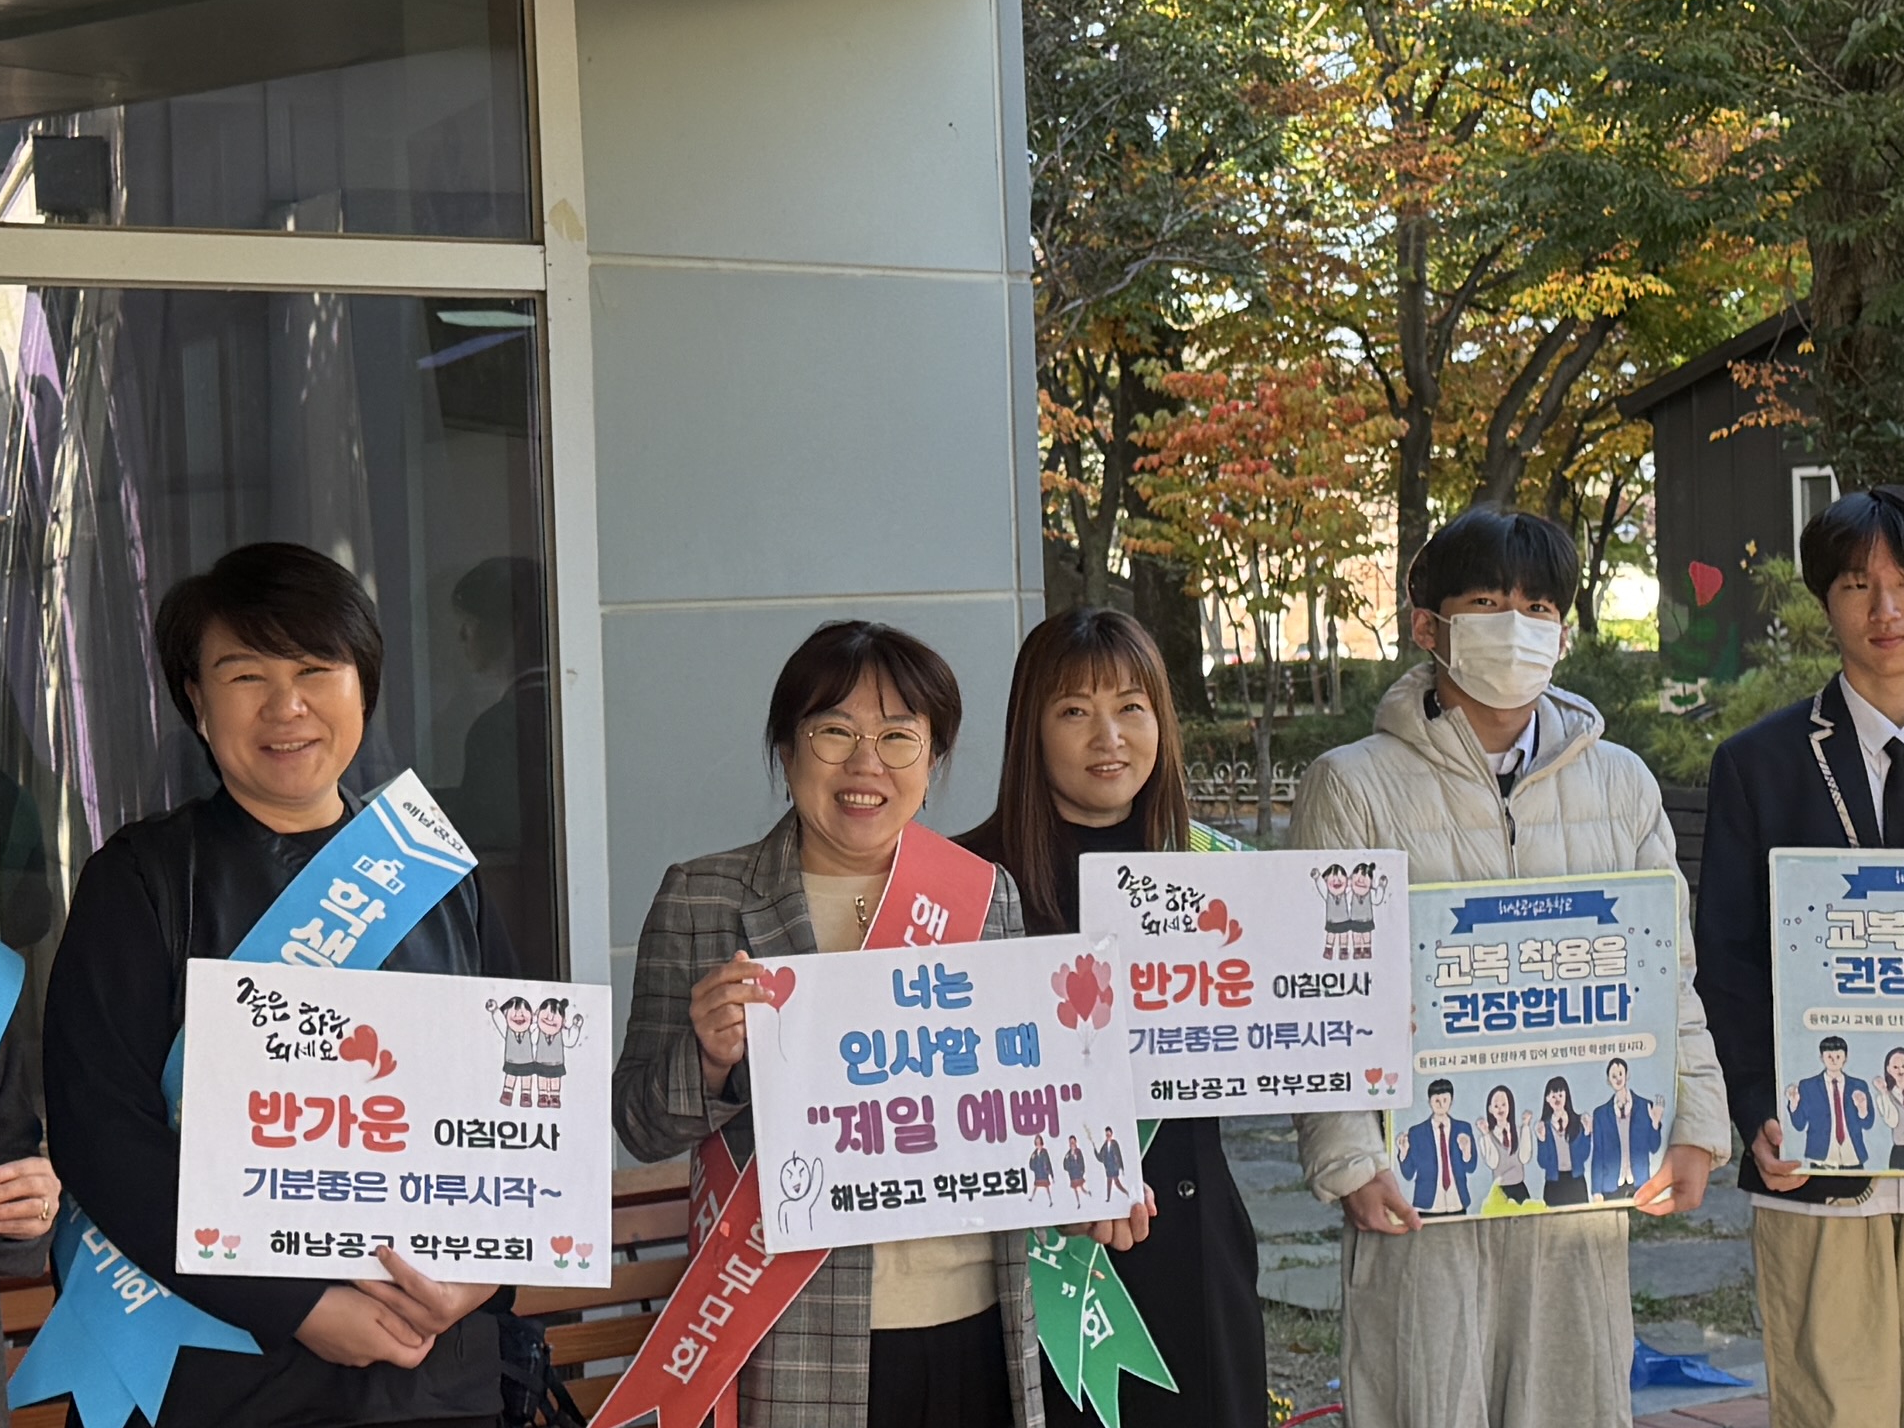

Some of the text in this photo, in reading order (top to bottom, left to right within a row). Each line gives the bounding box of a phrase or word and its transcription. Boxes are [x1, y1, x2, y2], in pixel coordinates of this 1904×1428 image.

[1117, 865, 1206, 913] 좋은 하루
[1141, 911, 1197, 936] 되세요
[1129, 958, 1372, 1011] 반가운 아침인사
[1434, 934, 1628, 988] 교복 착용을
[236, 976, 351, 1040] 좋은 하루
[892, 962, 973, 1010] 너는
[1443, 982, 1632, 1035] 권장합니다
[1128, 1020, 1373, 1055] 기분좋은 하루시작~
[1854, 1014, 1884, 1026] 교복을
[265, 1031, 339, 1063] 되세요
[839, 1021, 1041, 1086] 인사할 때
[1460, 1053, 1487, 1066] 교복을
[1150, 1071, 1351, 1101] 해남공고 학부모회
[248, 1089, 560, 1153] 반가운 아침인사
[806, 1082, 1082, 1155] "제일 예뻐"
[242, 1167, 563, 1208] 기분좋은 하루시작~
[830, 1167, 1028, 1213] 해남공고 학부모회
[269, 1229, 534, 1263] 해남공고 학부모회
